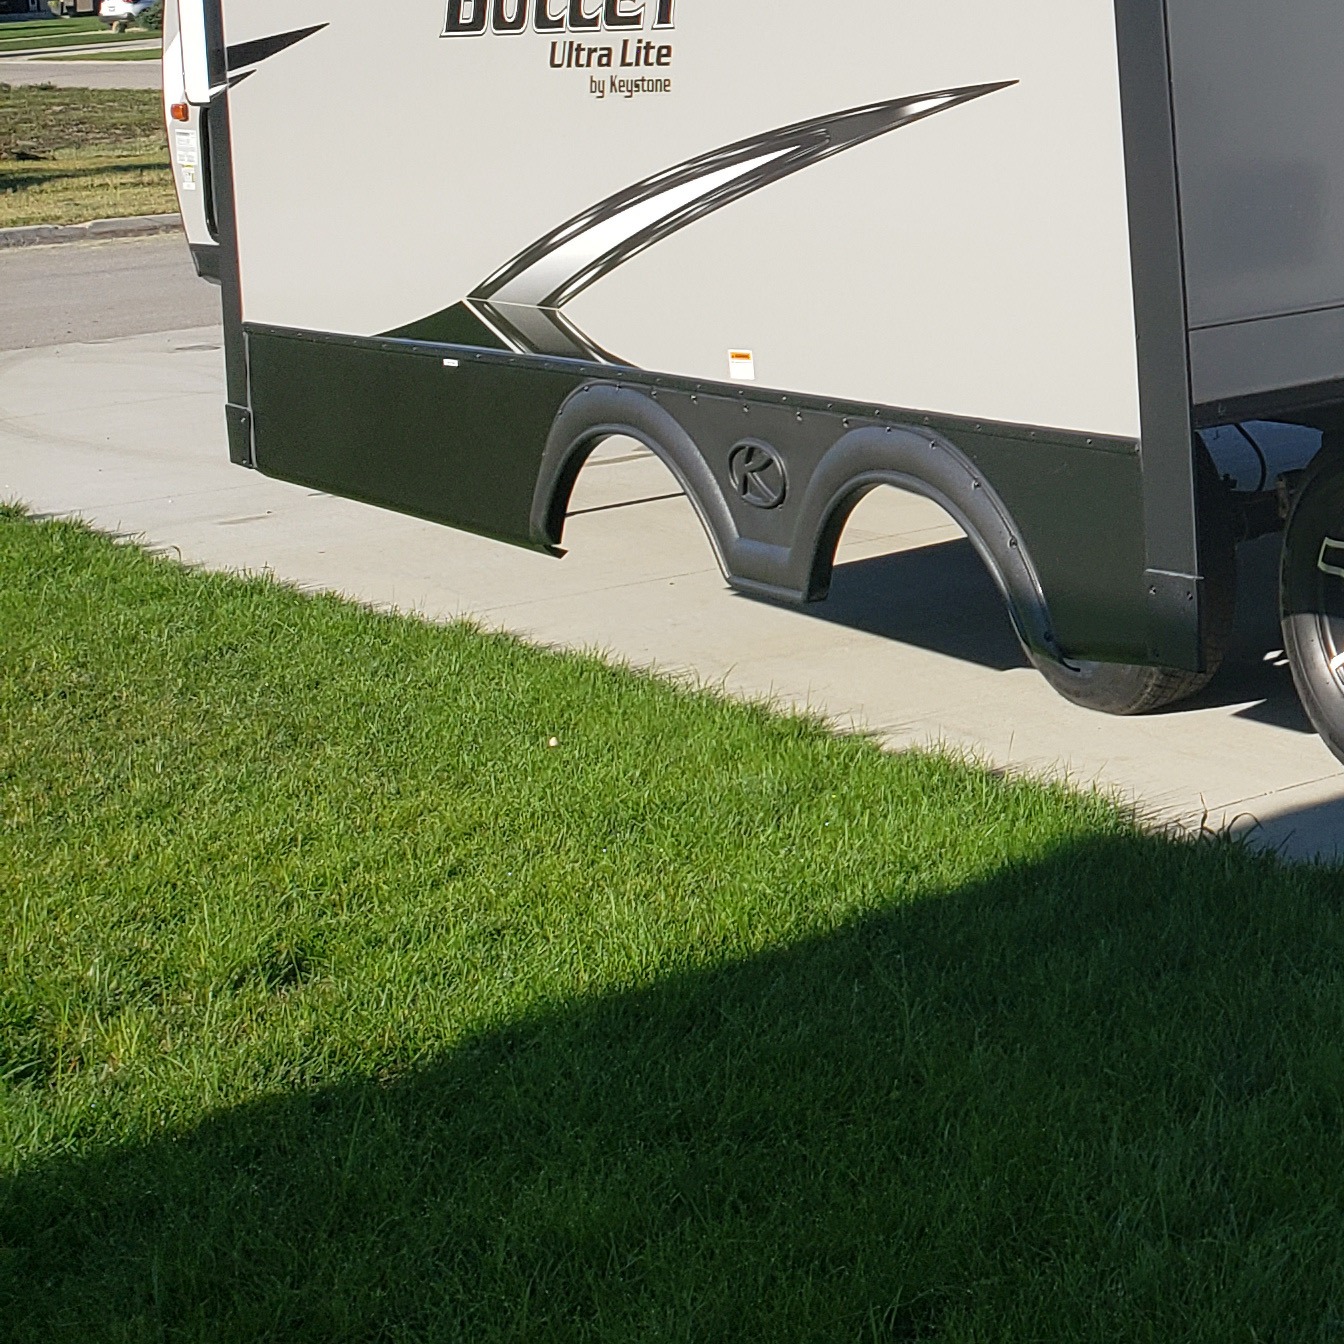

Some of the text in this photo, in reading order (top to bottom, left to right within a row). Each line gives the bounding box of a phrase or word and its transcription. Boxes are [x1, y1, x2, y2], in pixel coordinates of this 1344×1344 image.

[549, 39, 672, 68] Ultra Lite
[589, 75, 671, 99] by Keystone
